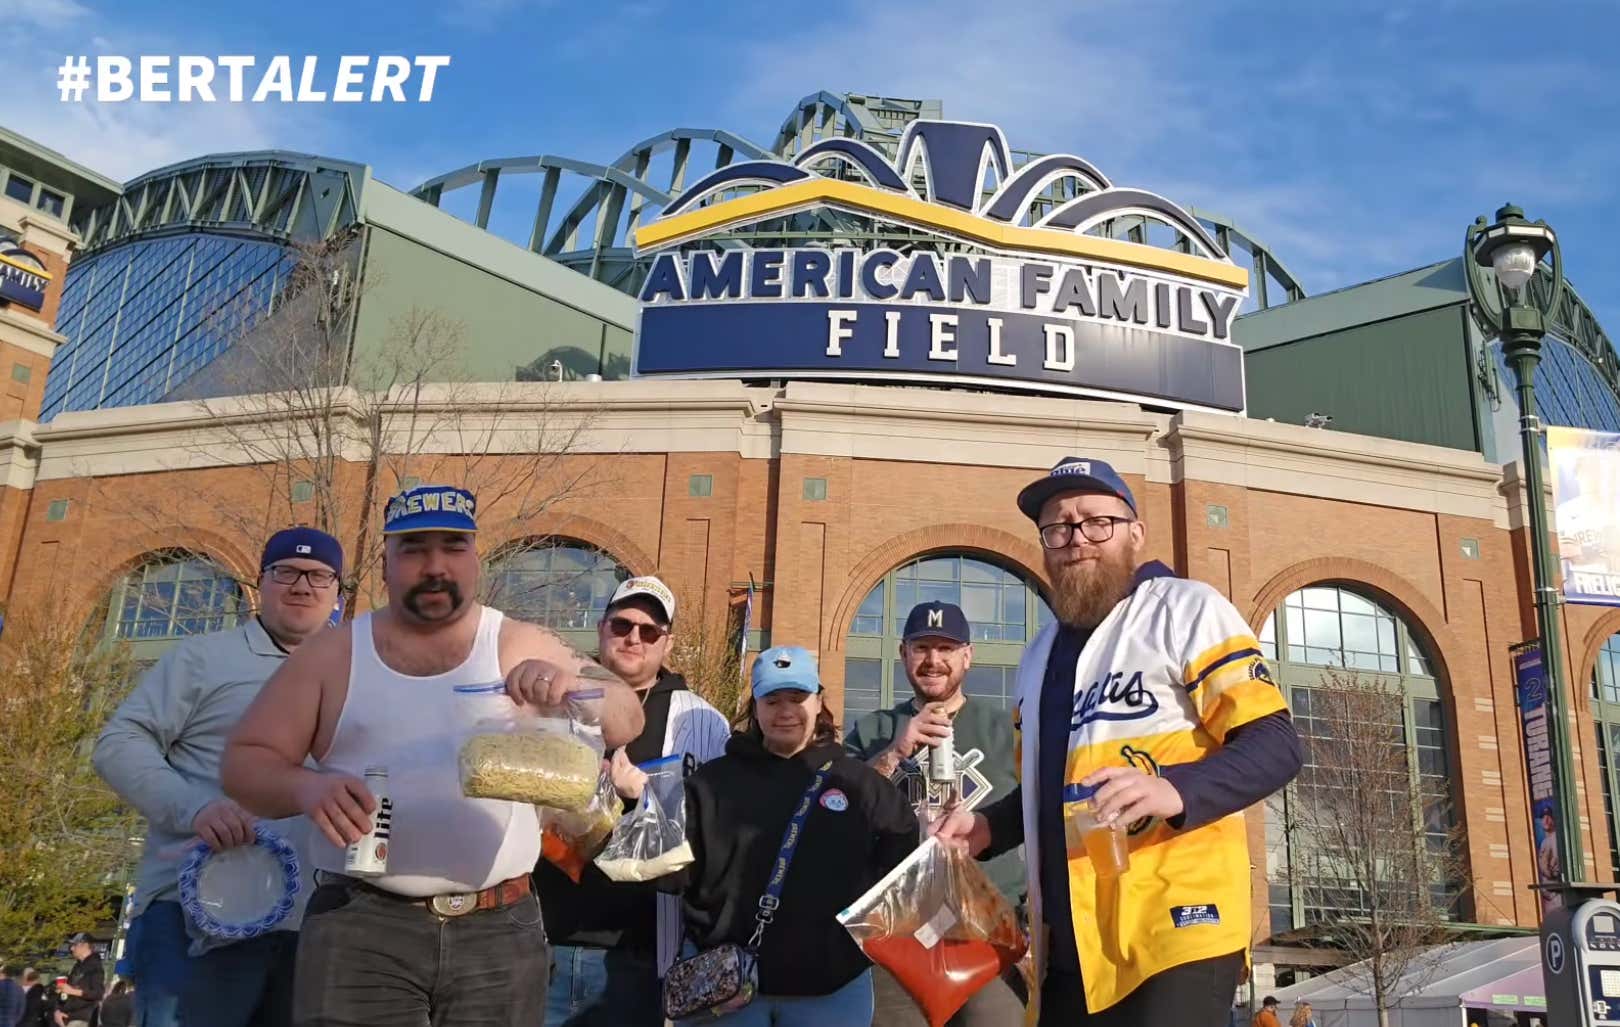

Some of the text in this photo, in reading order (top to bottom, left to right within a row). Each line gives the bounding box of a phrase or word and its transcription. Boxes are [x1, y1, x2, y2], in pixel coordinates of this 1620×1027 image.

[641, 250, 1237, 338] AMERICAN FAMILY
[826, 309, 1075, 371] FIELD
[928, 609, 943, 628] M
[1525, 677, 1543, 699] 2
[1550, 940, 1561, 968] P
